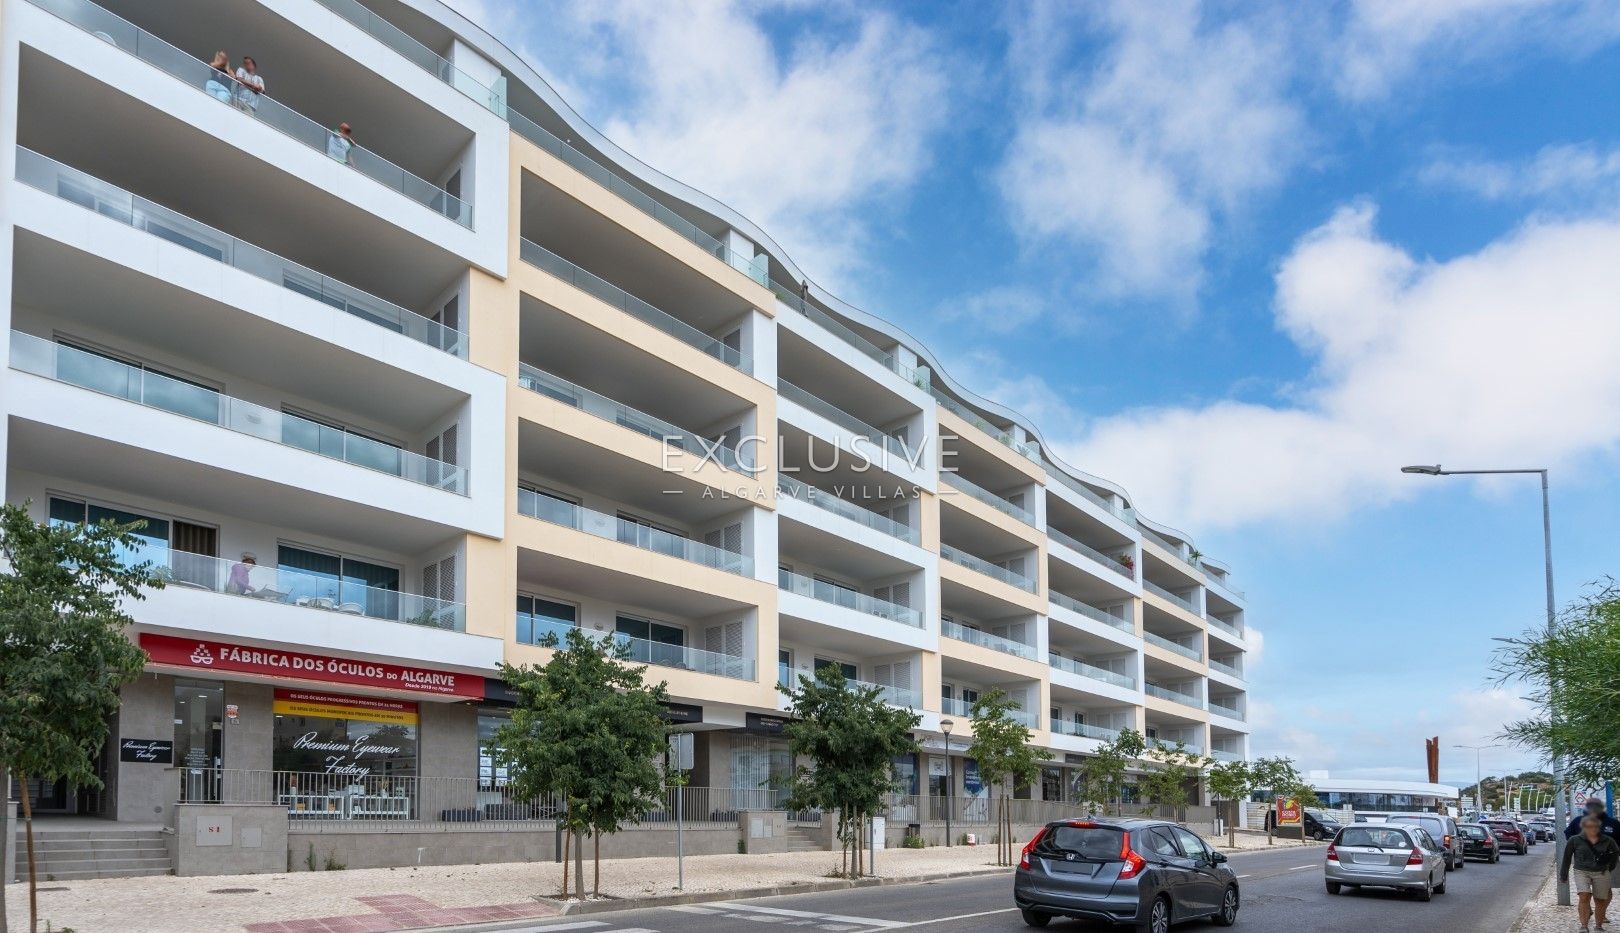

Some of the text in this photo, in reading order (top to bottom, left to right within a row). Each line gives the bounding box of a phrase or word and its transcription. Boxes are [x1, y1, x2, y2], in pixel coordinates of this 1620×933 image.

[220, 647, 455, 687] FÁBRICA DOS ÓCULOS DO ALGARVE
[294, 731, 400, 760] Premium Eyewear
[325, 755, 371, 782] Factory
